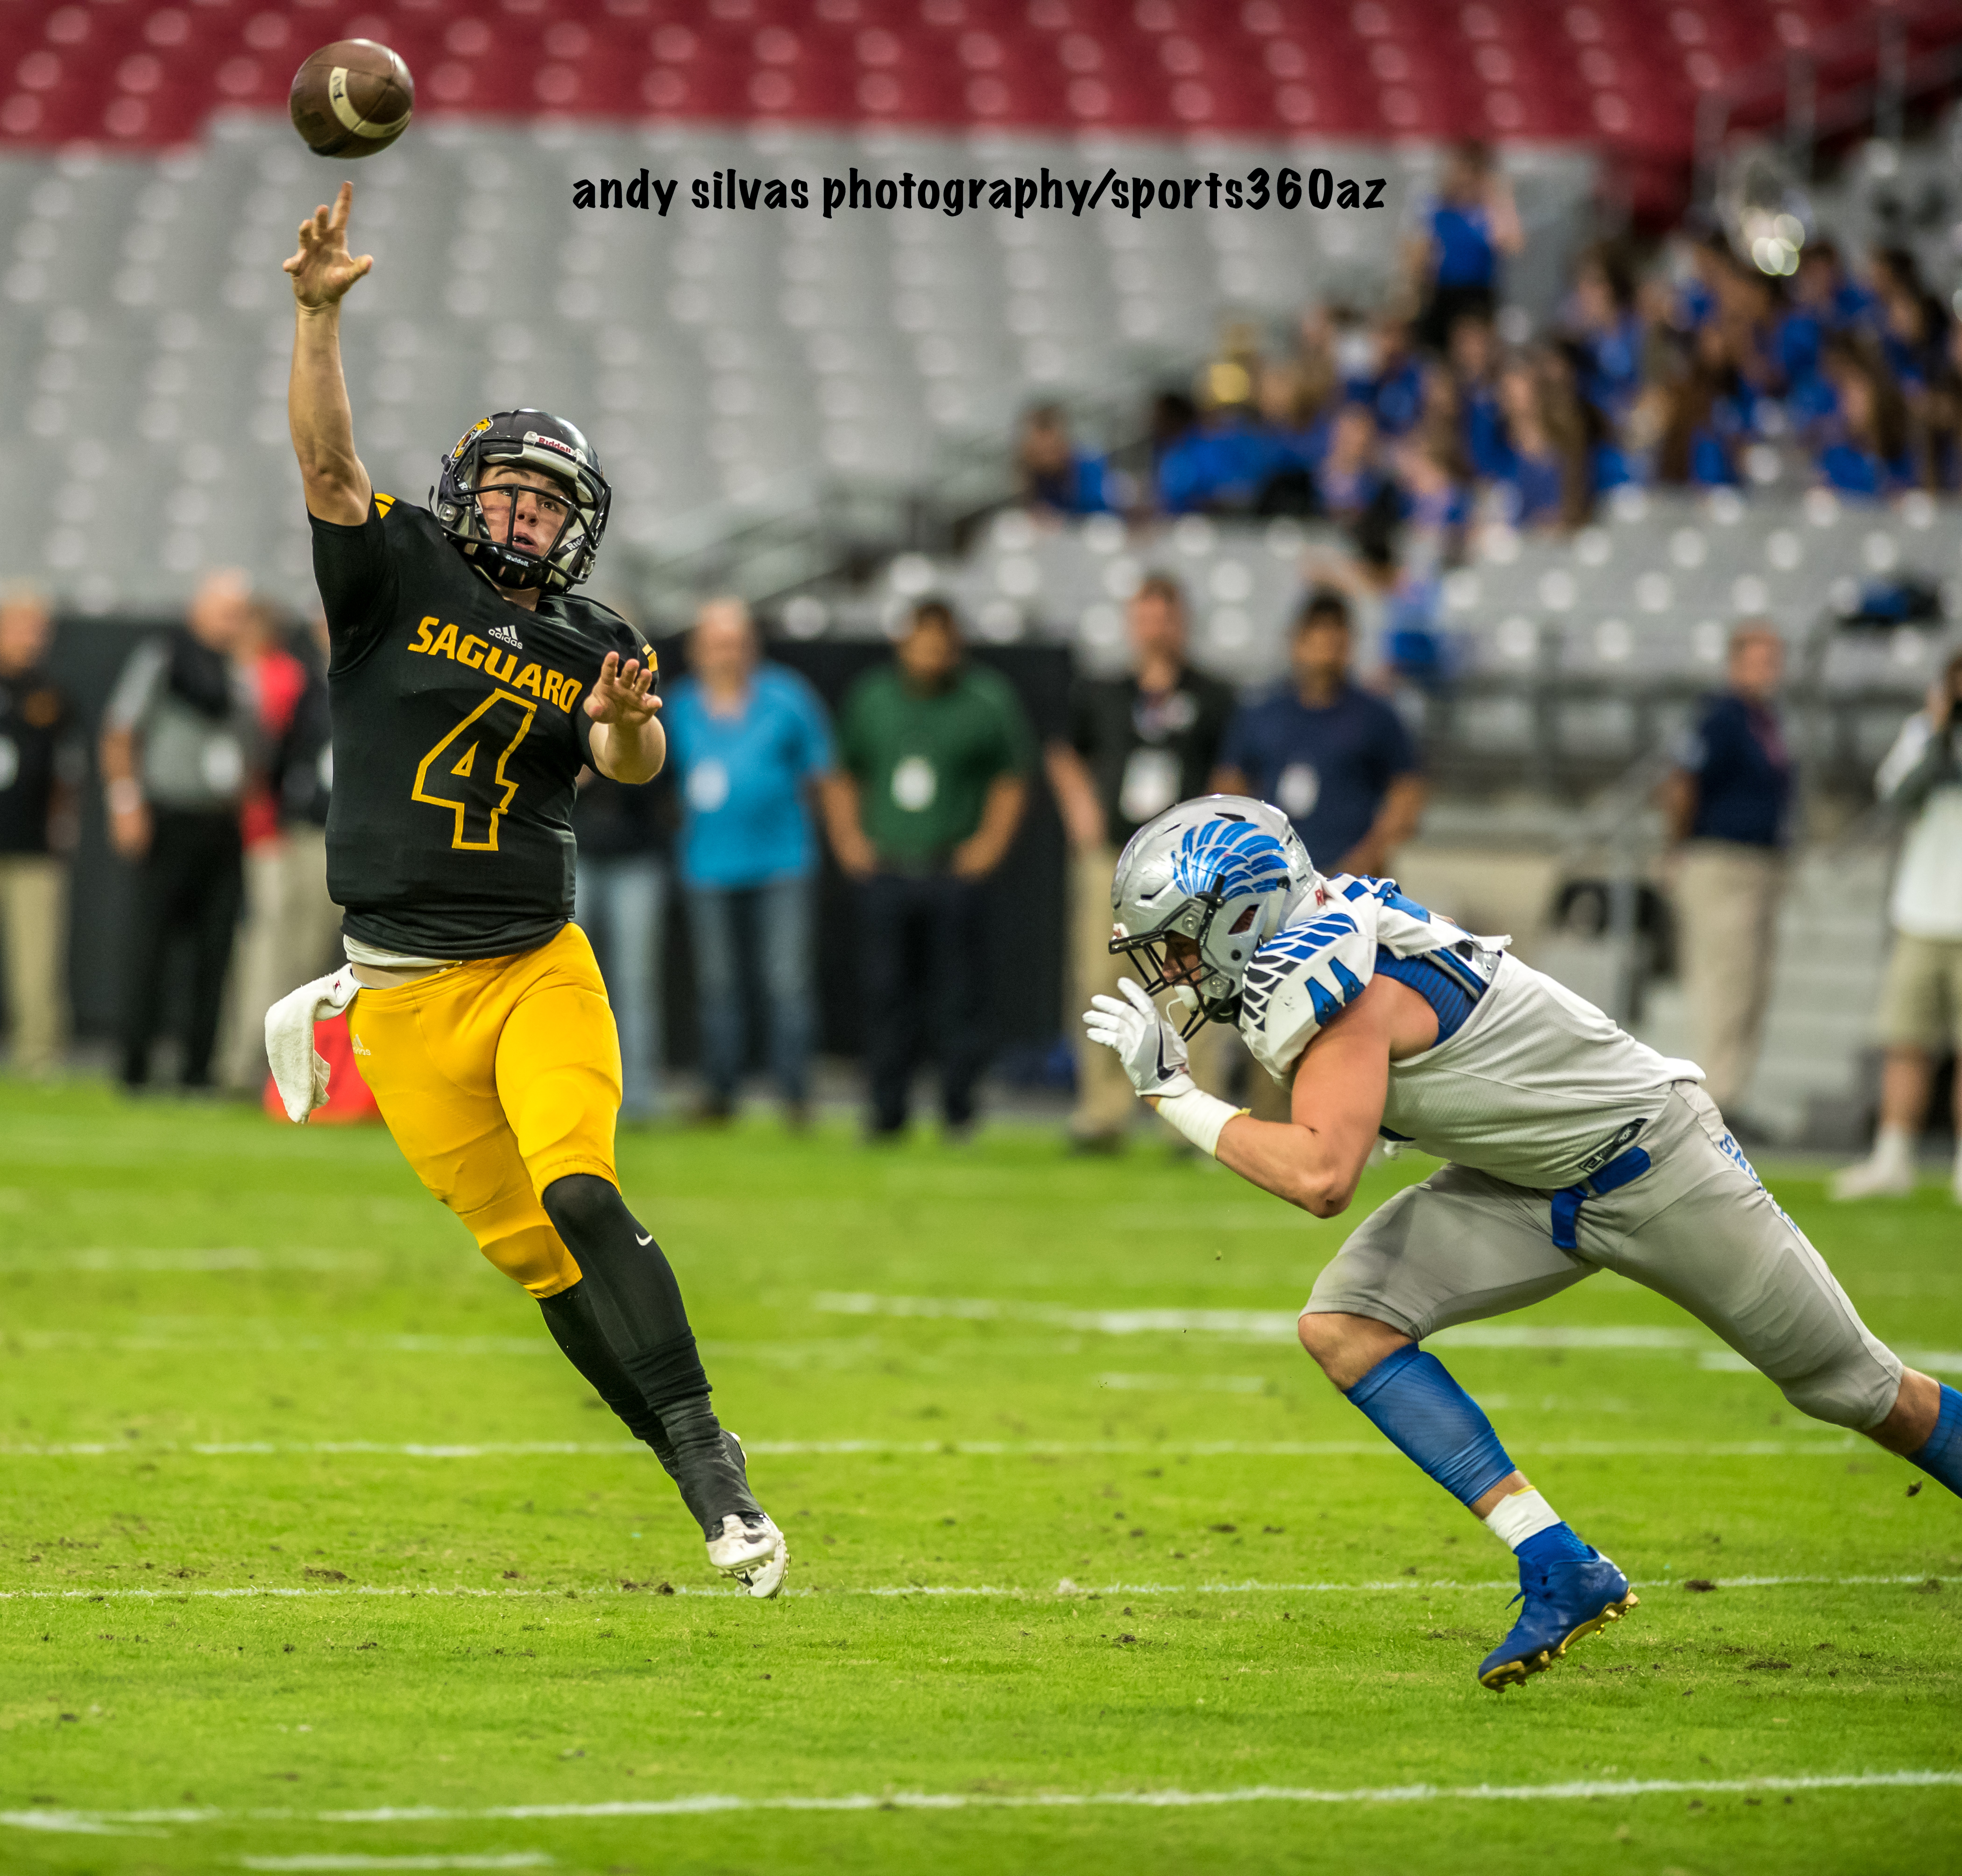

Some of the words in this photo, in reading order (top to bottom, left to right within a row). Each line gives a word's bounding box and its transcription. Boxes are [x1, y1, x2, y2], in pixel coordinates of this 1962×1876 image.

[538, 437, 571, 453] Riddell
[407, 616, 582, 714] SAGUARO
[488, 629, 523, 649] adidas
[411, 687, 538, 851] 4
